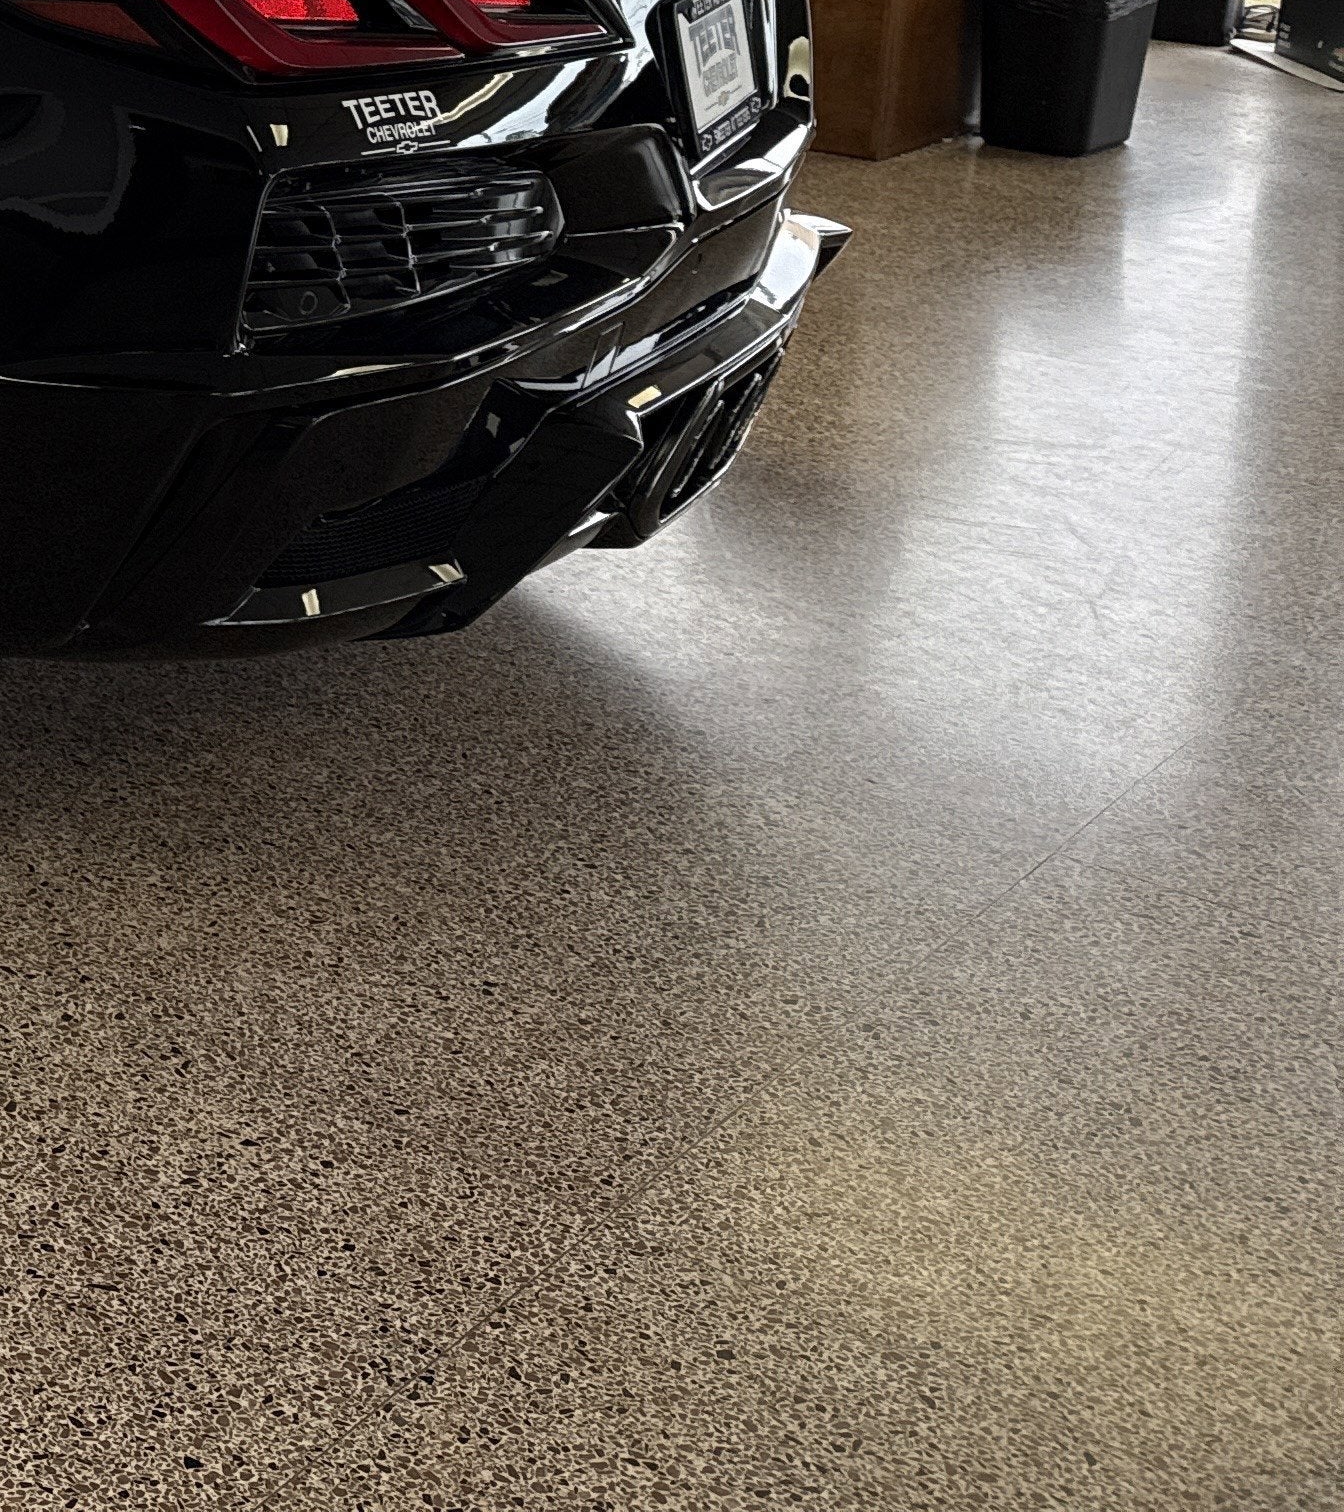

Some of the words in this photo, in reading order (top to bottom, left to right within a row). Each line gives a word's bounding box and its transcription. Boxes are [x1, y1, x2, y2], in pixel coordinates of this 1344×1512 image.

[688, 4, 741, 79] TEETER
[341, 90, 444, 130] TEETER
[366, 119, 436, 144] CHEVROLET
